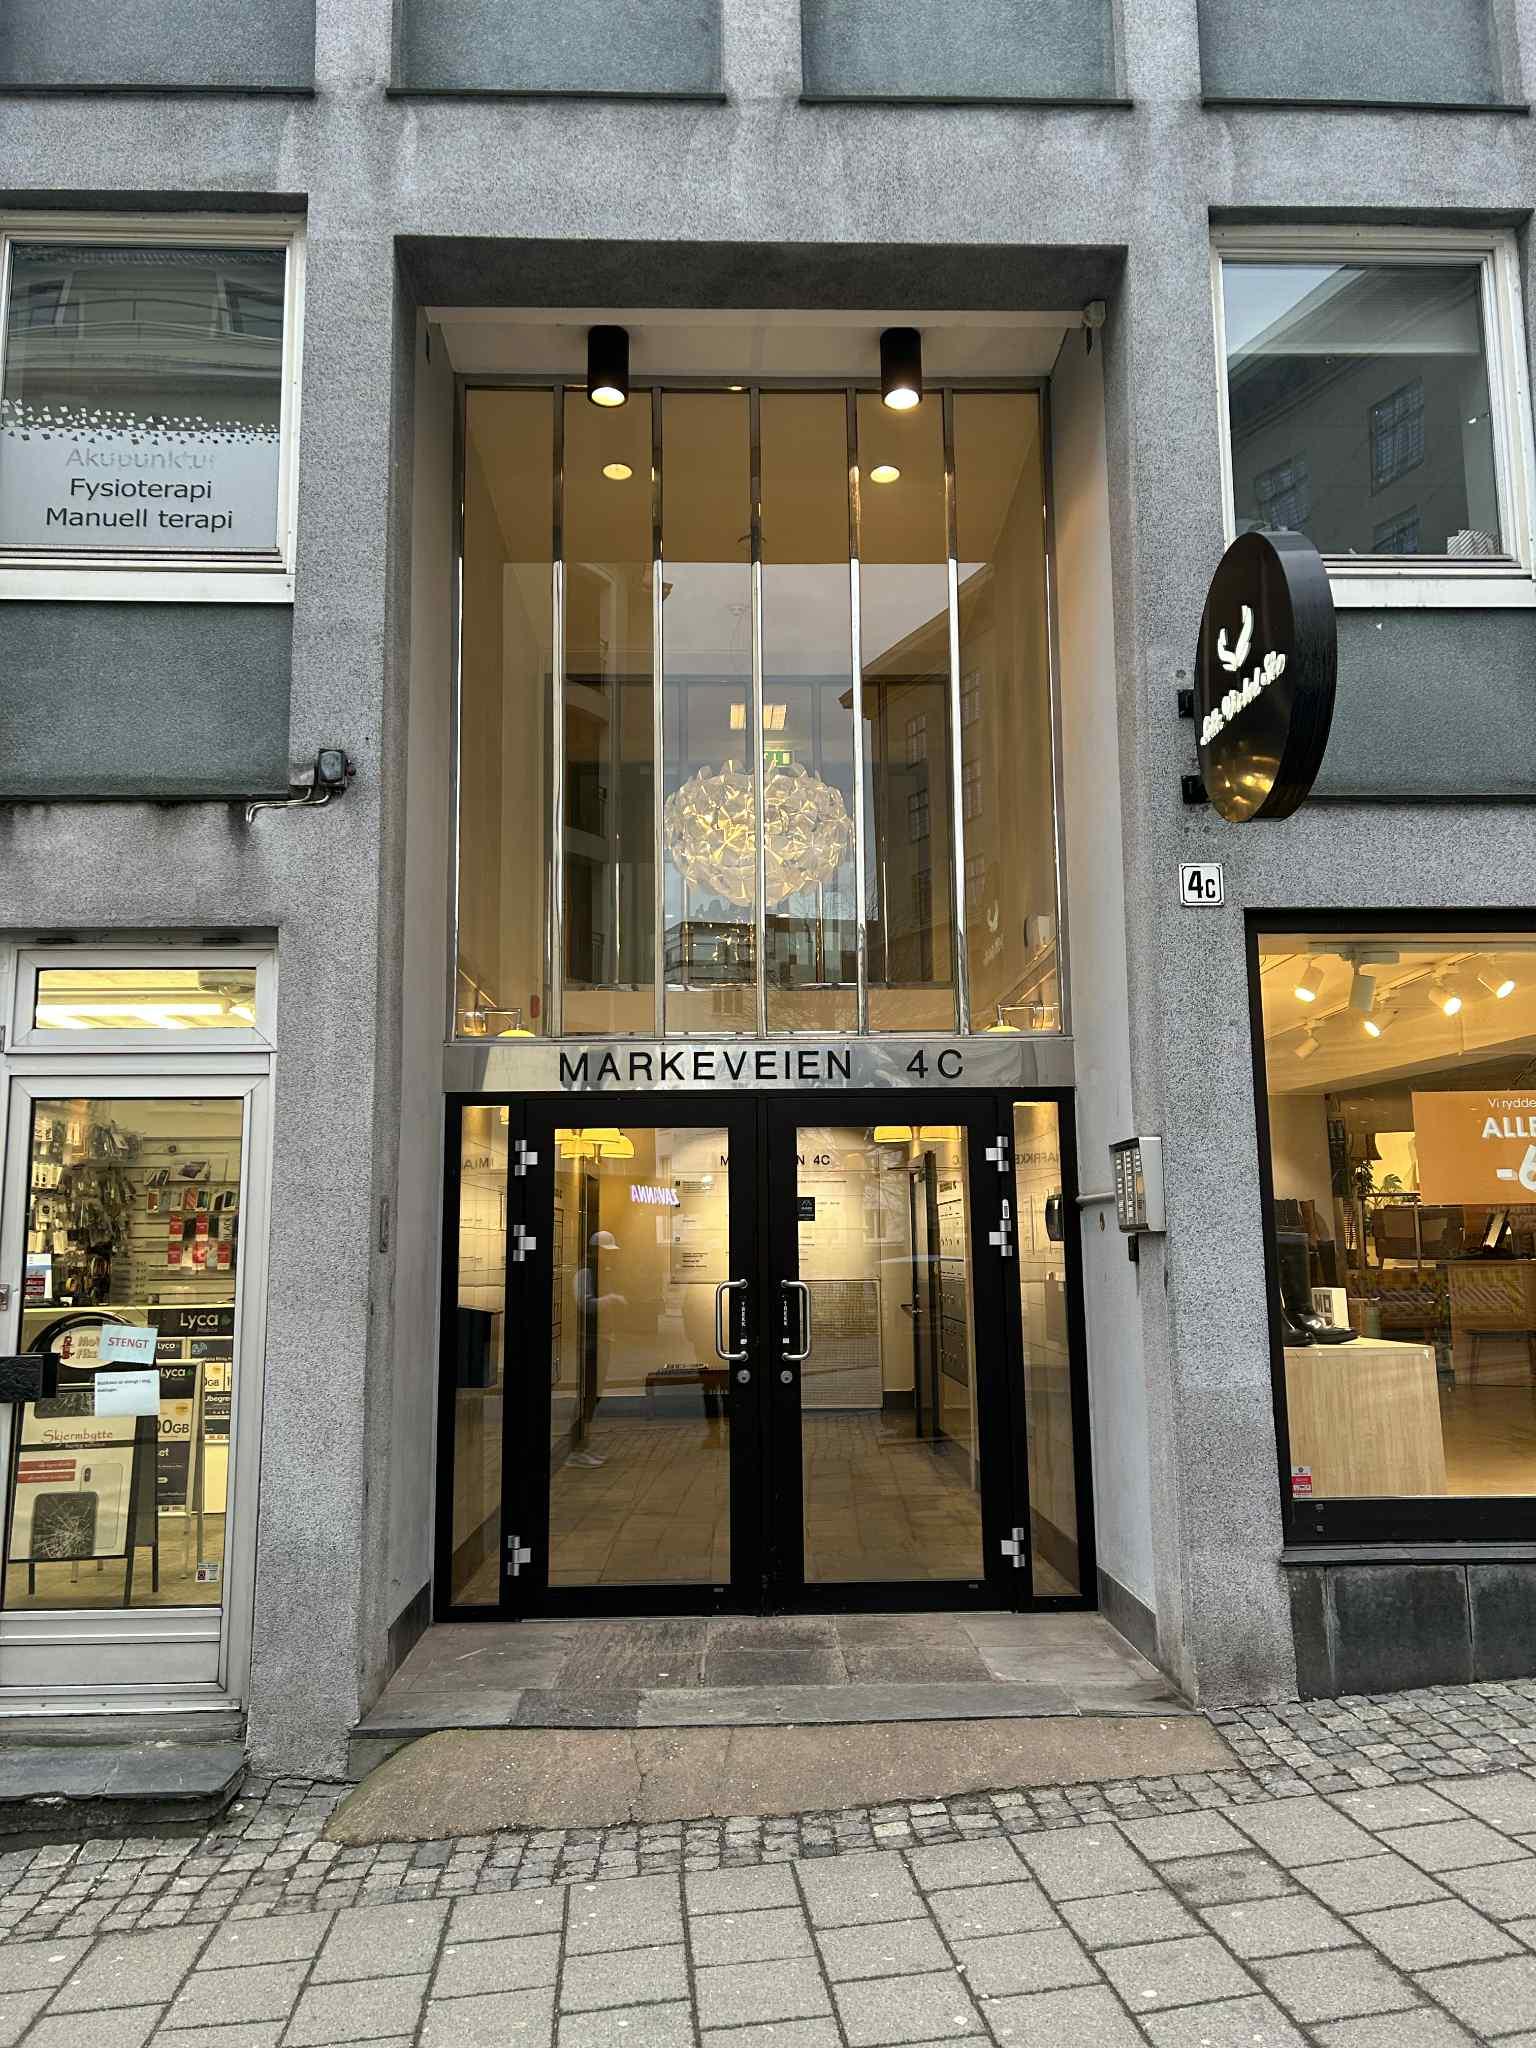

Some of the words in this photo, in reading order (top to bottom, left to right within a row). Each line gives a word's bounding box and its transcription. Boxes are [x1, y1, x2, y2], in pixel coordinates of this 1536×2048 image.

[70, 478, 212, 503] Fysioterapi
[46, 507, 148, 527] Manuell
[158, 510, 233, 533] terapi
[559, 1050, 851, 1082] MARKEVEIEN
[906, 1048, 964, 1079] 4C
[813, 1155, 831, 1165] 4C
[180, 1312, 219, 1329] Lyca
[107, 1337, 150, 1349] STENGT
[160, 1367, 186, 1379] Lyca
